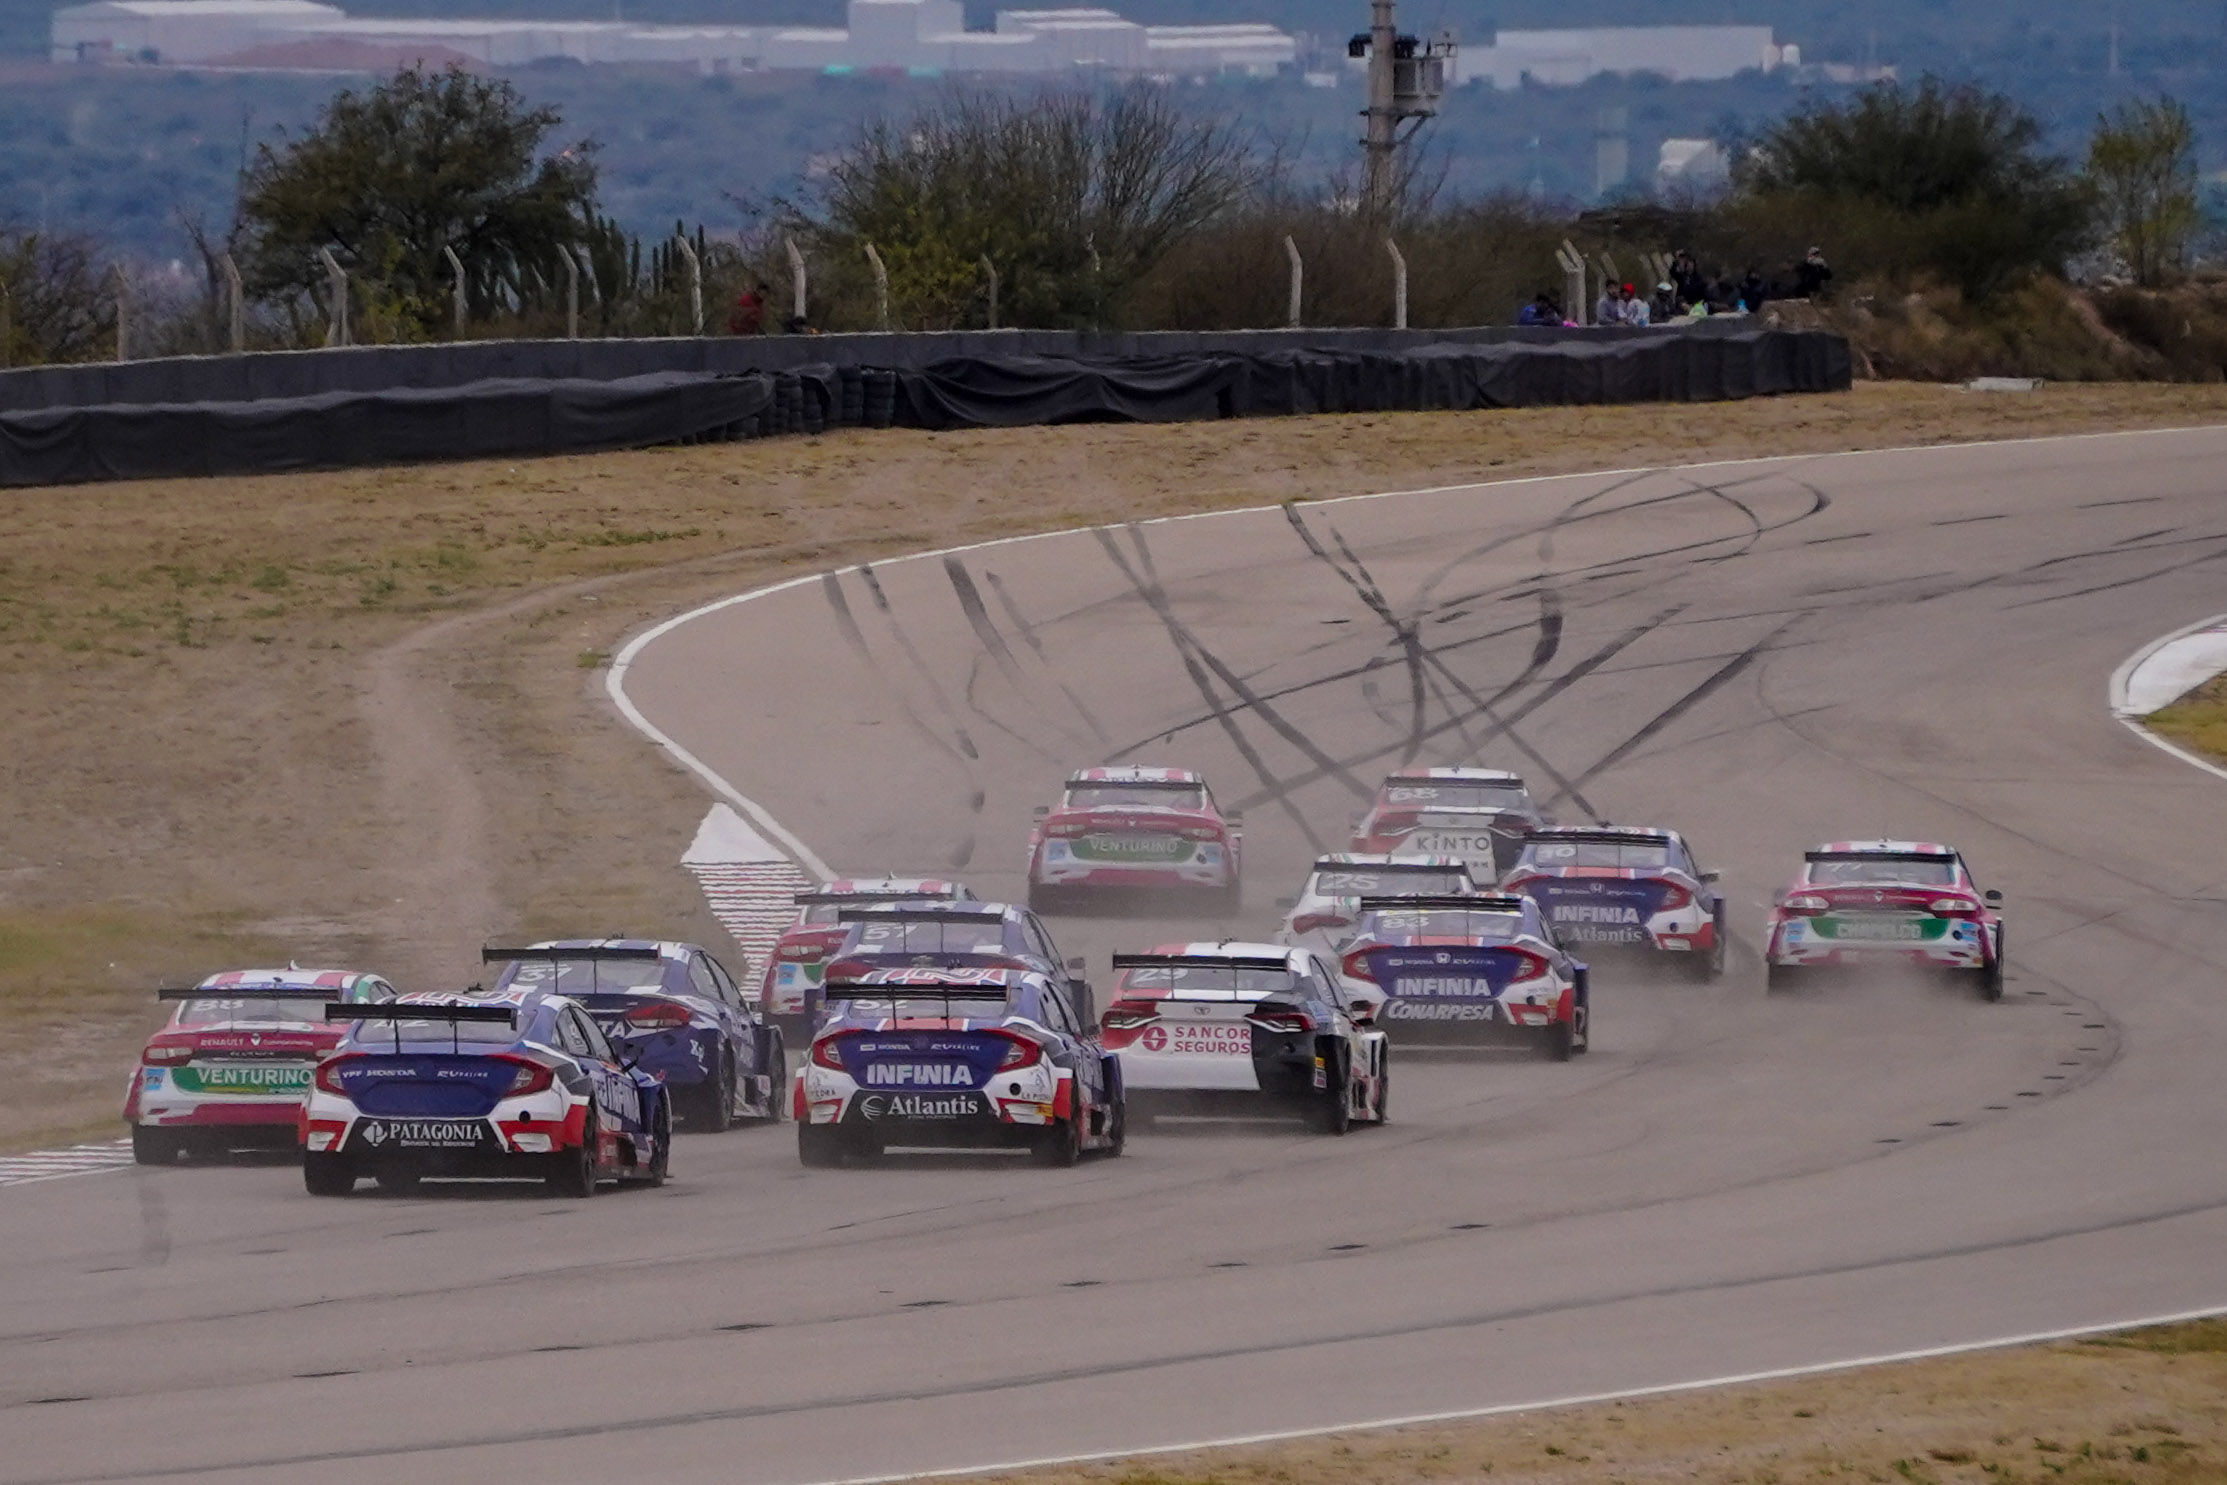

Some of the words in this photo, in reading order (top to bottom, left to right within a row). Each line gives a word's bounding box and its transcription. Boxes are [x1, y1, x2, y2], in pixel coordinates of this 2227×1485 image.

[1089, 840, 1178, 853] VENTURINO
[1321, 873, 1381, 890] 25
[1554, 905, 1640, 924] INFINIA
[1568, 926, 1643, 942] Atlantis
[1395, 978, 1492, 996] INFINIA
[1174, 1026, 1251, 1040] SANCOR
[200, 1038, 244, 1047] RENAULT
[1174, 1041, 1251, 1055] SEGUROS
[197, 1069, 313, 1085] VENTURINO
[866, 1064, 974, 1085] INFINIA
[887, 1096, 978, 1115] Atlantis
[389, 1123, 484, 1140] PATAGONIA
